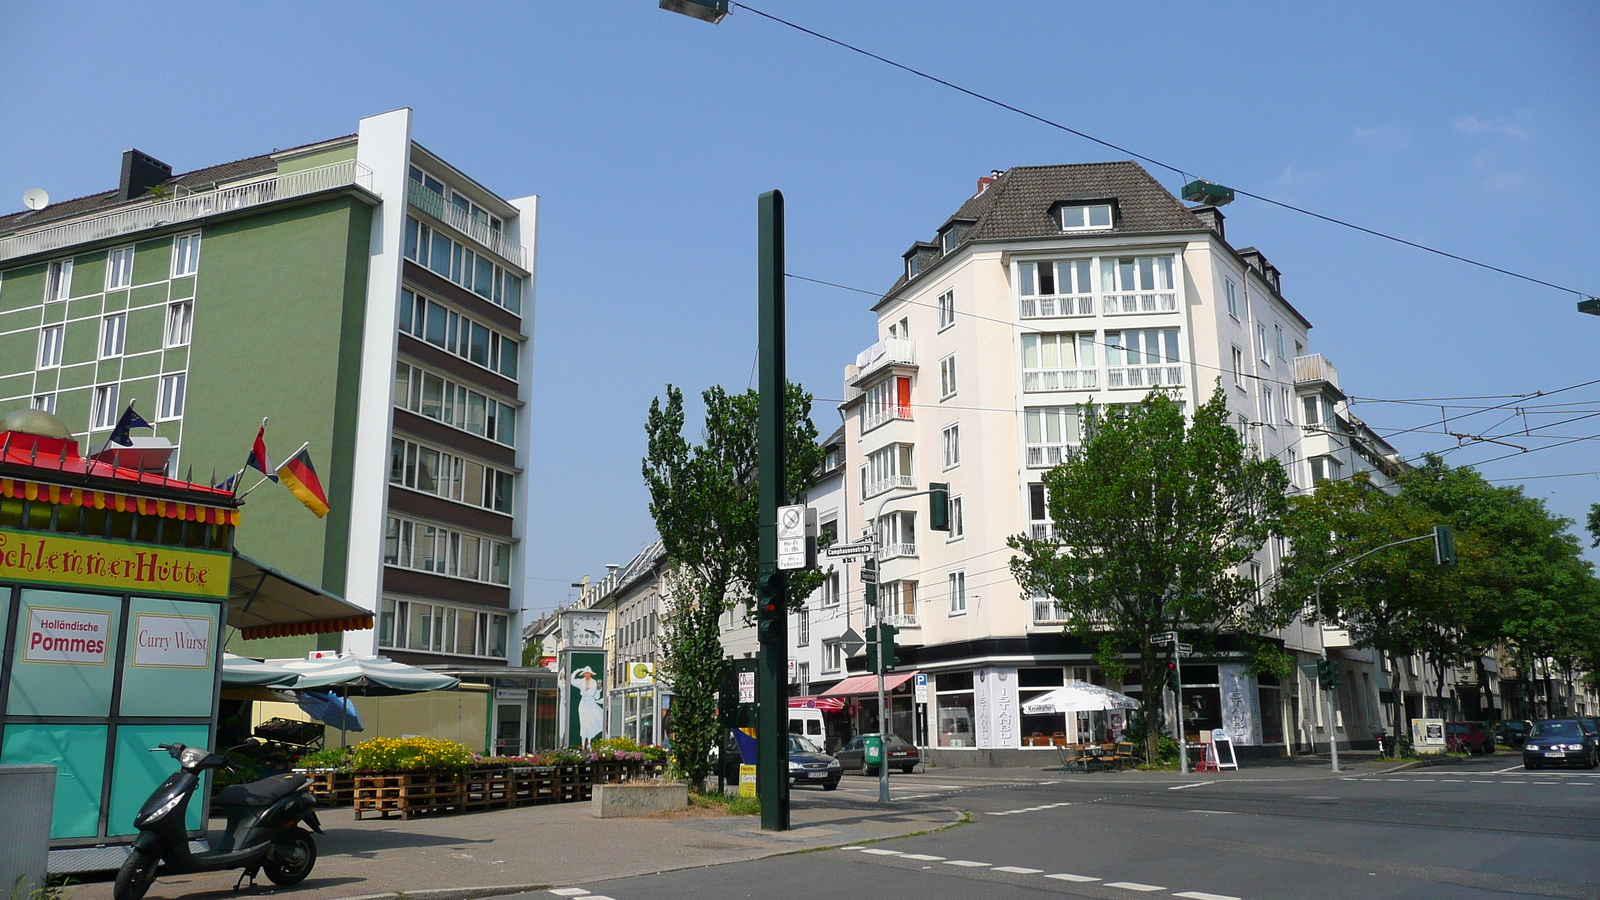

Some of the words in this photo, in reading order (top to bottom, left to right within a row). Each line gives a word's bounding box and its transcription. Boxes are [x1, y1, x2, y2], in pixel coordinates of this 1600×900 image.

[41, 619, 99, 632] Holländische
[30, 632, 104, 654] Pommes
[138, 629, 172, 651] Curry
[174, 631, 207, 650] Wurst
[917, 675, 925, 685] P
[999, 688, 1012, 747] ISTANBUL
